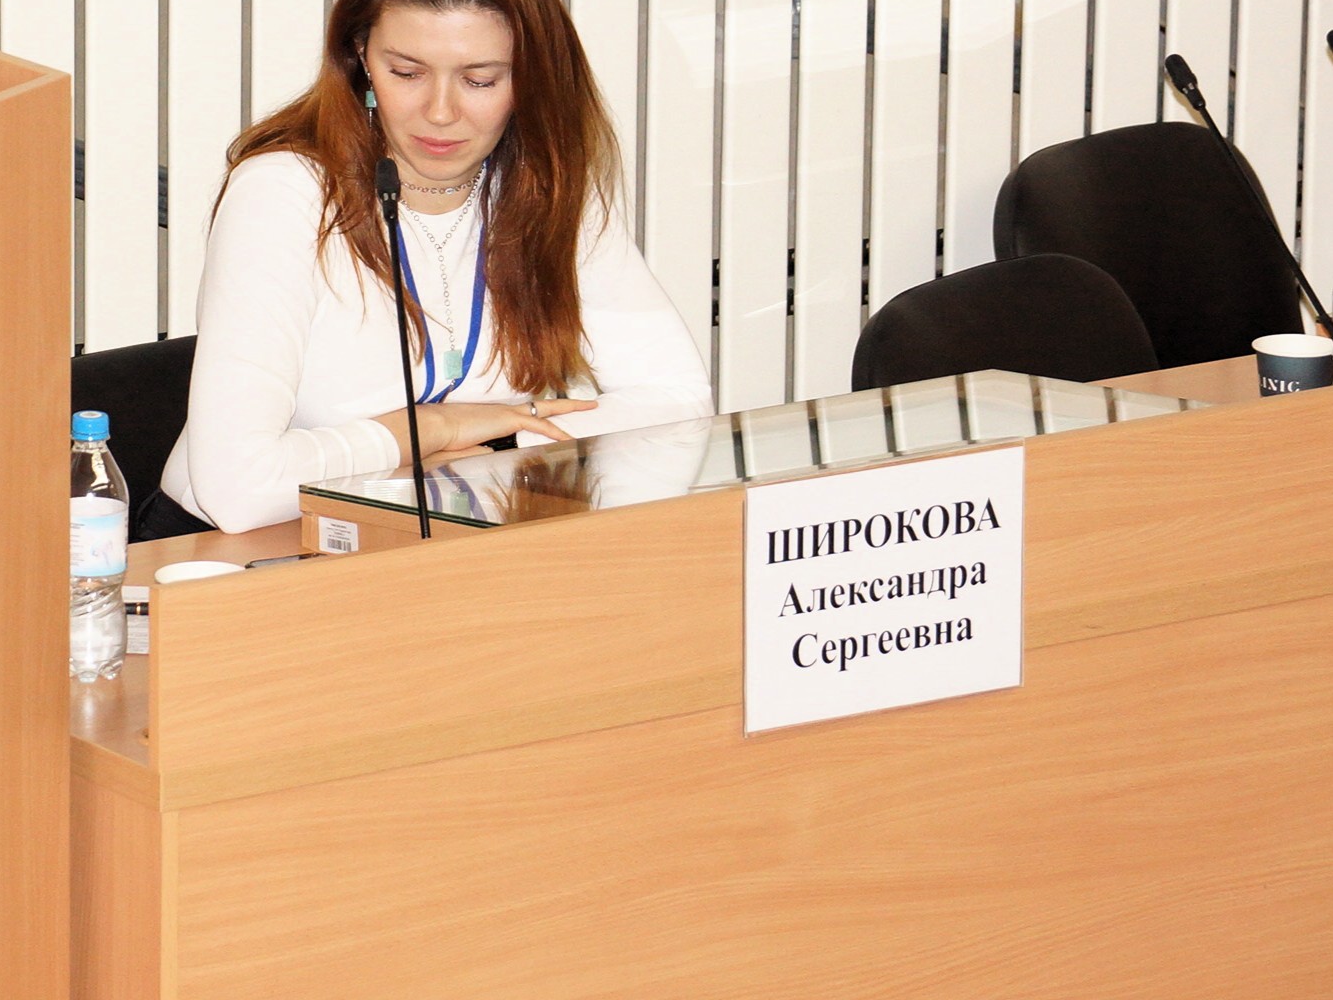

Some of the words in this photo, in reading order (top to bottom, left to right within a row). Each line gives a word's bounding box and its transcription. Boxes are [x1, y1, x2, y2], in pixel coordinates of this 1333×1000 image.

[1261, 376, 1300, 393] INIC
[766, 498, 1000, 565] ШИРОКОВА
[778, 561, 987, 617] Александра
[792, 617, 973, 671] Сергеевна
